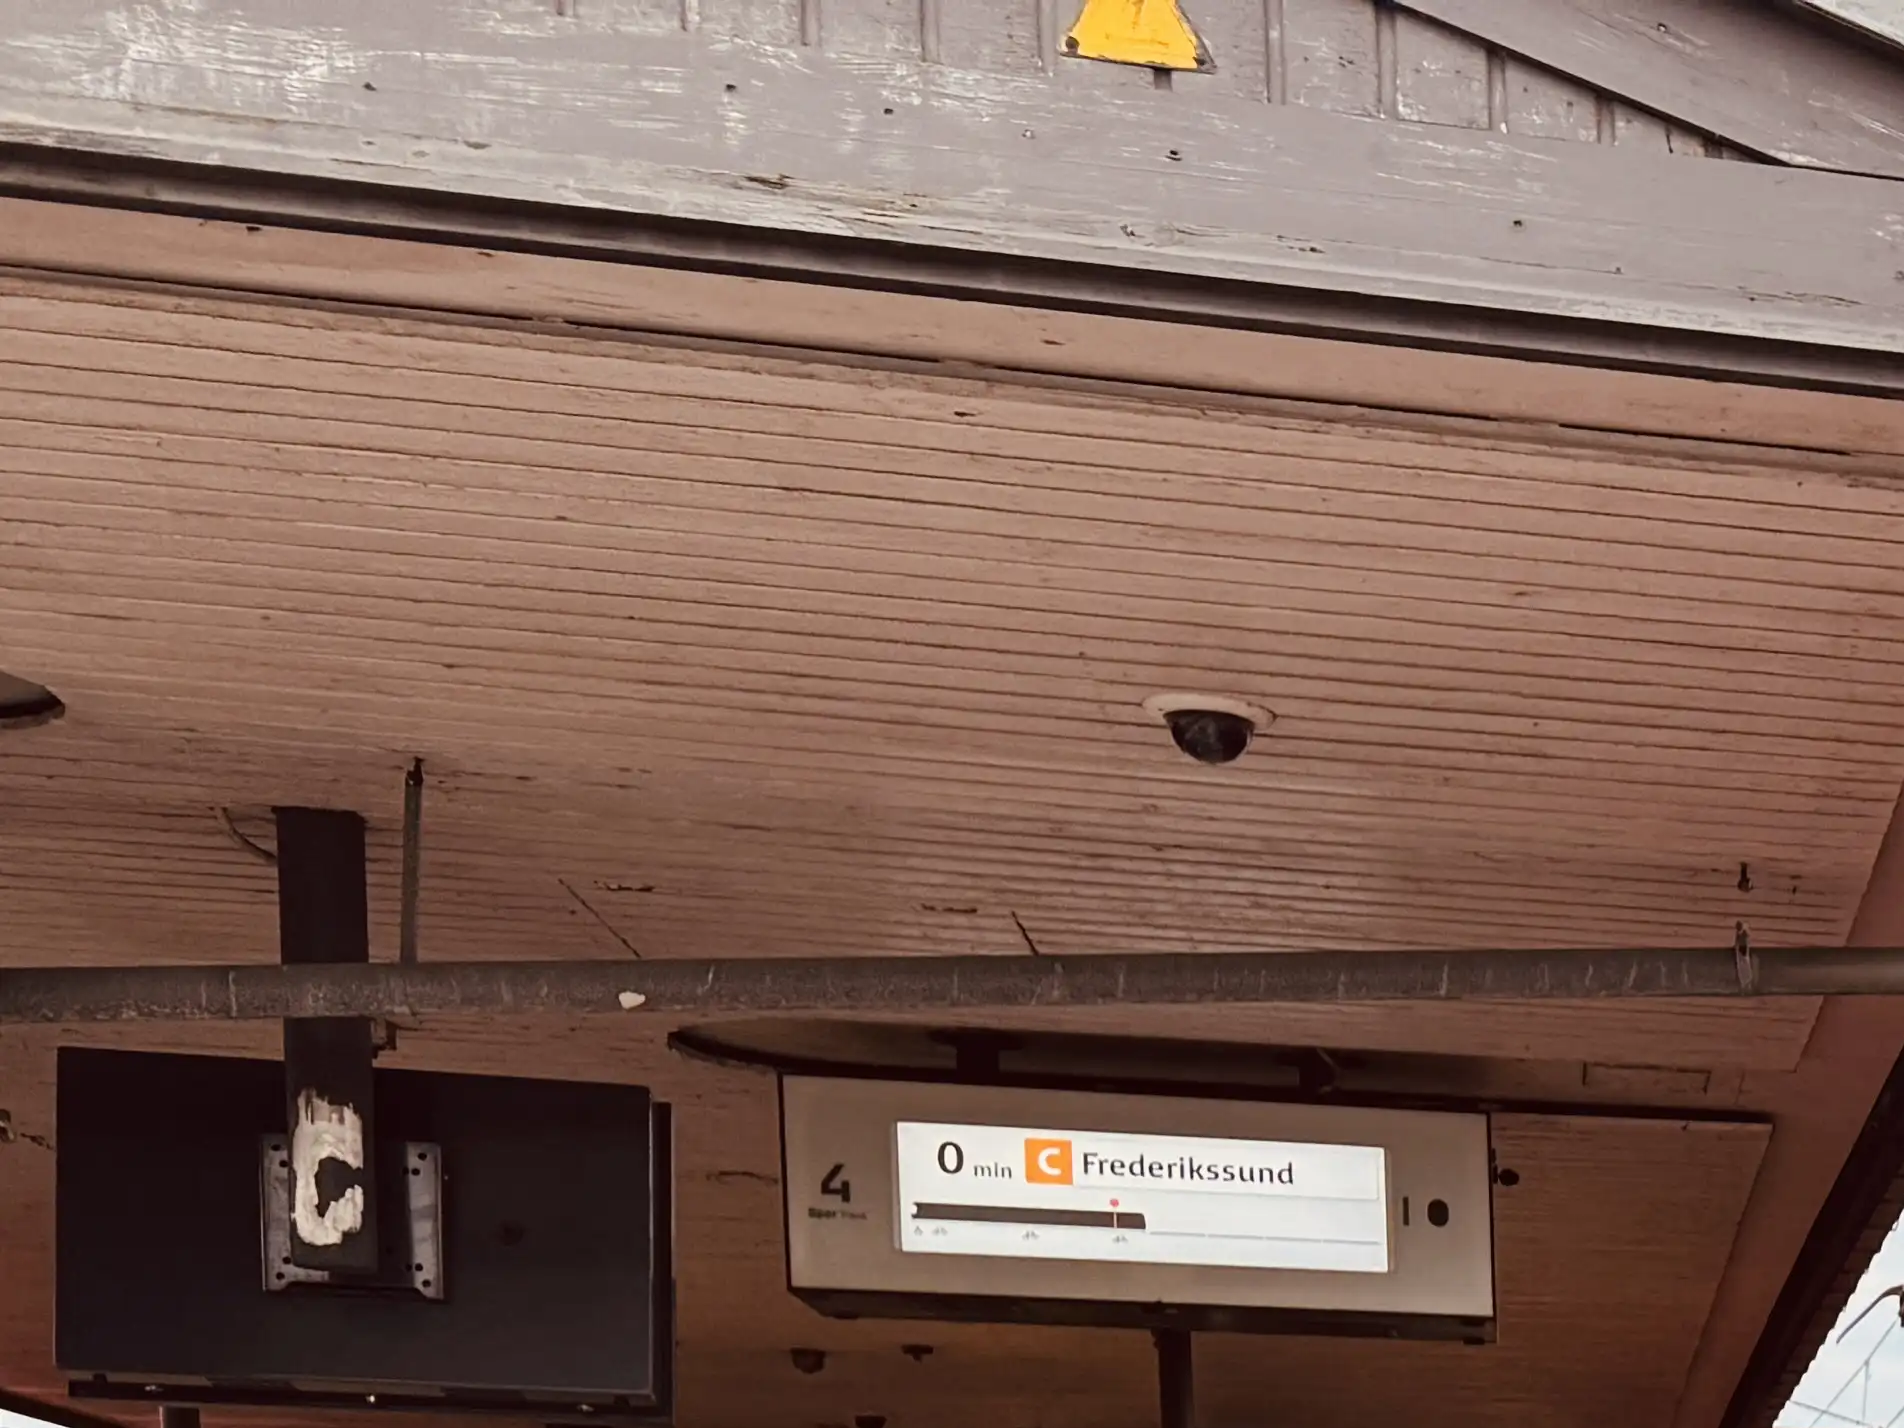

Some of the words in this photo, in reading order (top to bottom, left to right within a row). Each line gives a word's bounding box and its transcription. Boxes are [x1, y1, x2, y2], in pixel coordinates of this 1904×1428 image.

[820, 1163, 851, 1203] 4
[937, 1141, 965, 1175] 0
[973, 1162, 1012, 1179] min
[1037, 1147, 1062, 1177] C
[1082, 1151, 1294, 1185] Frederikssund
